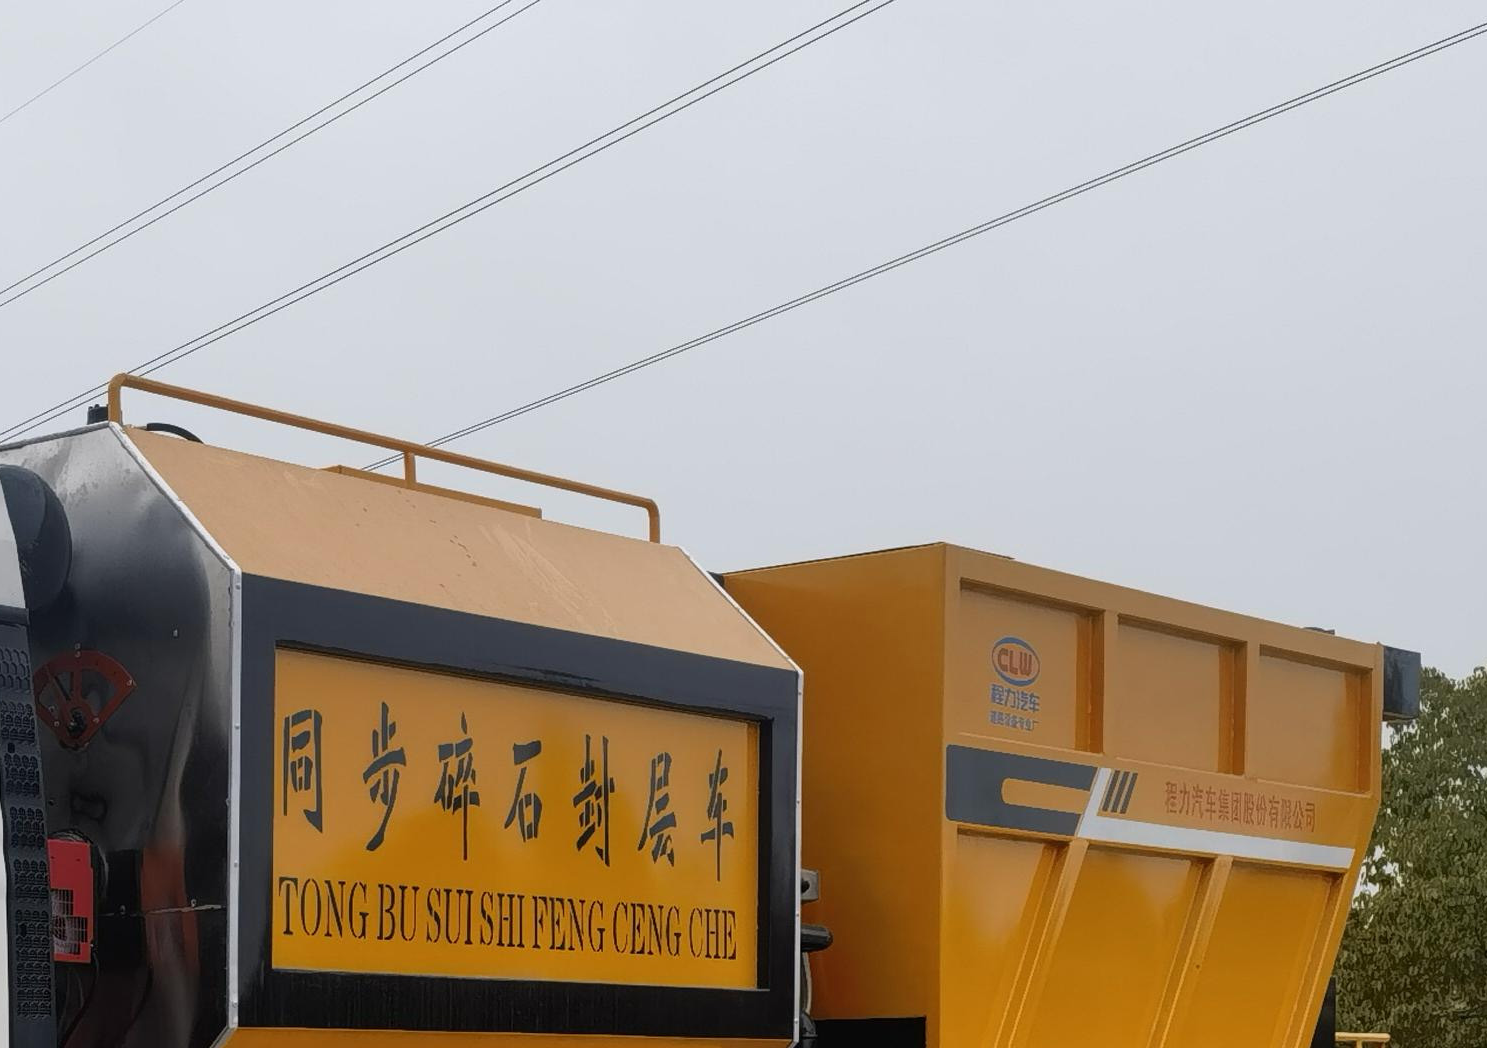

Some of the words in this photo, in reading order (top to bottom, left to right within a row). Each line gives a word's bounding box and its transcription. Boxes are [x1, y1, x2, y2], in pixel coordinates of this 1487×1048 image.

[997, 647, 1033, 677] CLW
[990, 683, 1040, 712] 程力汽车
[282, 701, 735, 882] 同步碎石封层车
[1165, 781, 1315, 832] 程力汽车集团股份有限公司
[279, 876, 369, 940] TONG
[376, 882, 420, 942] BU
[425, 886, 474, 946] SUI
[479, 890, 526, 949] SHI
[531, 894, 606, 953] FENG
[612, 900, 682, 959] CENG
[688, 905, 737, 960] CHE
